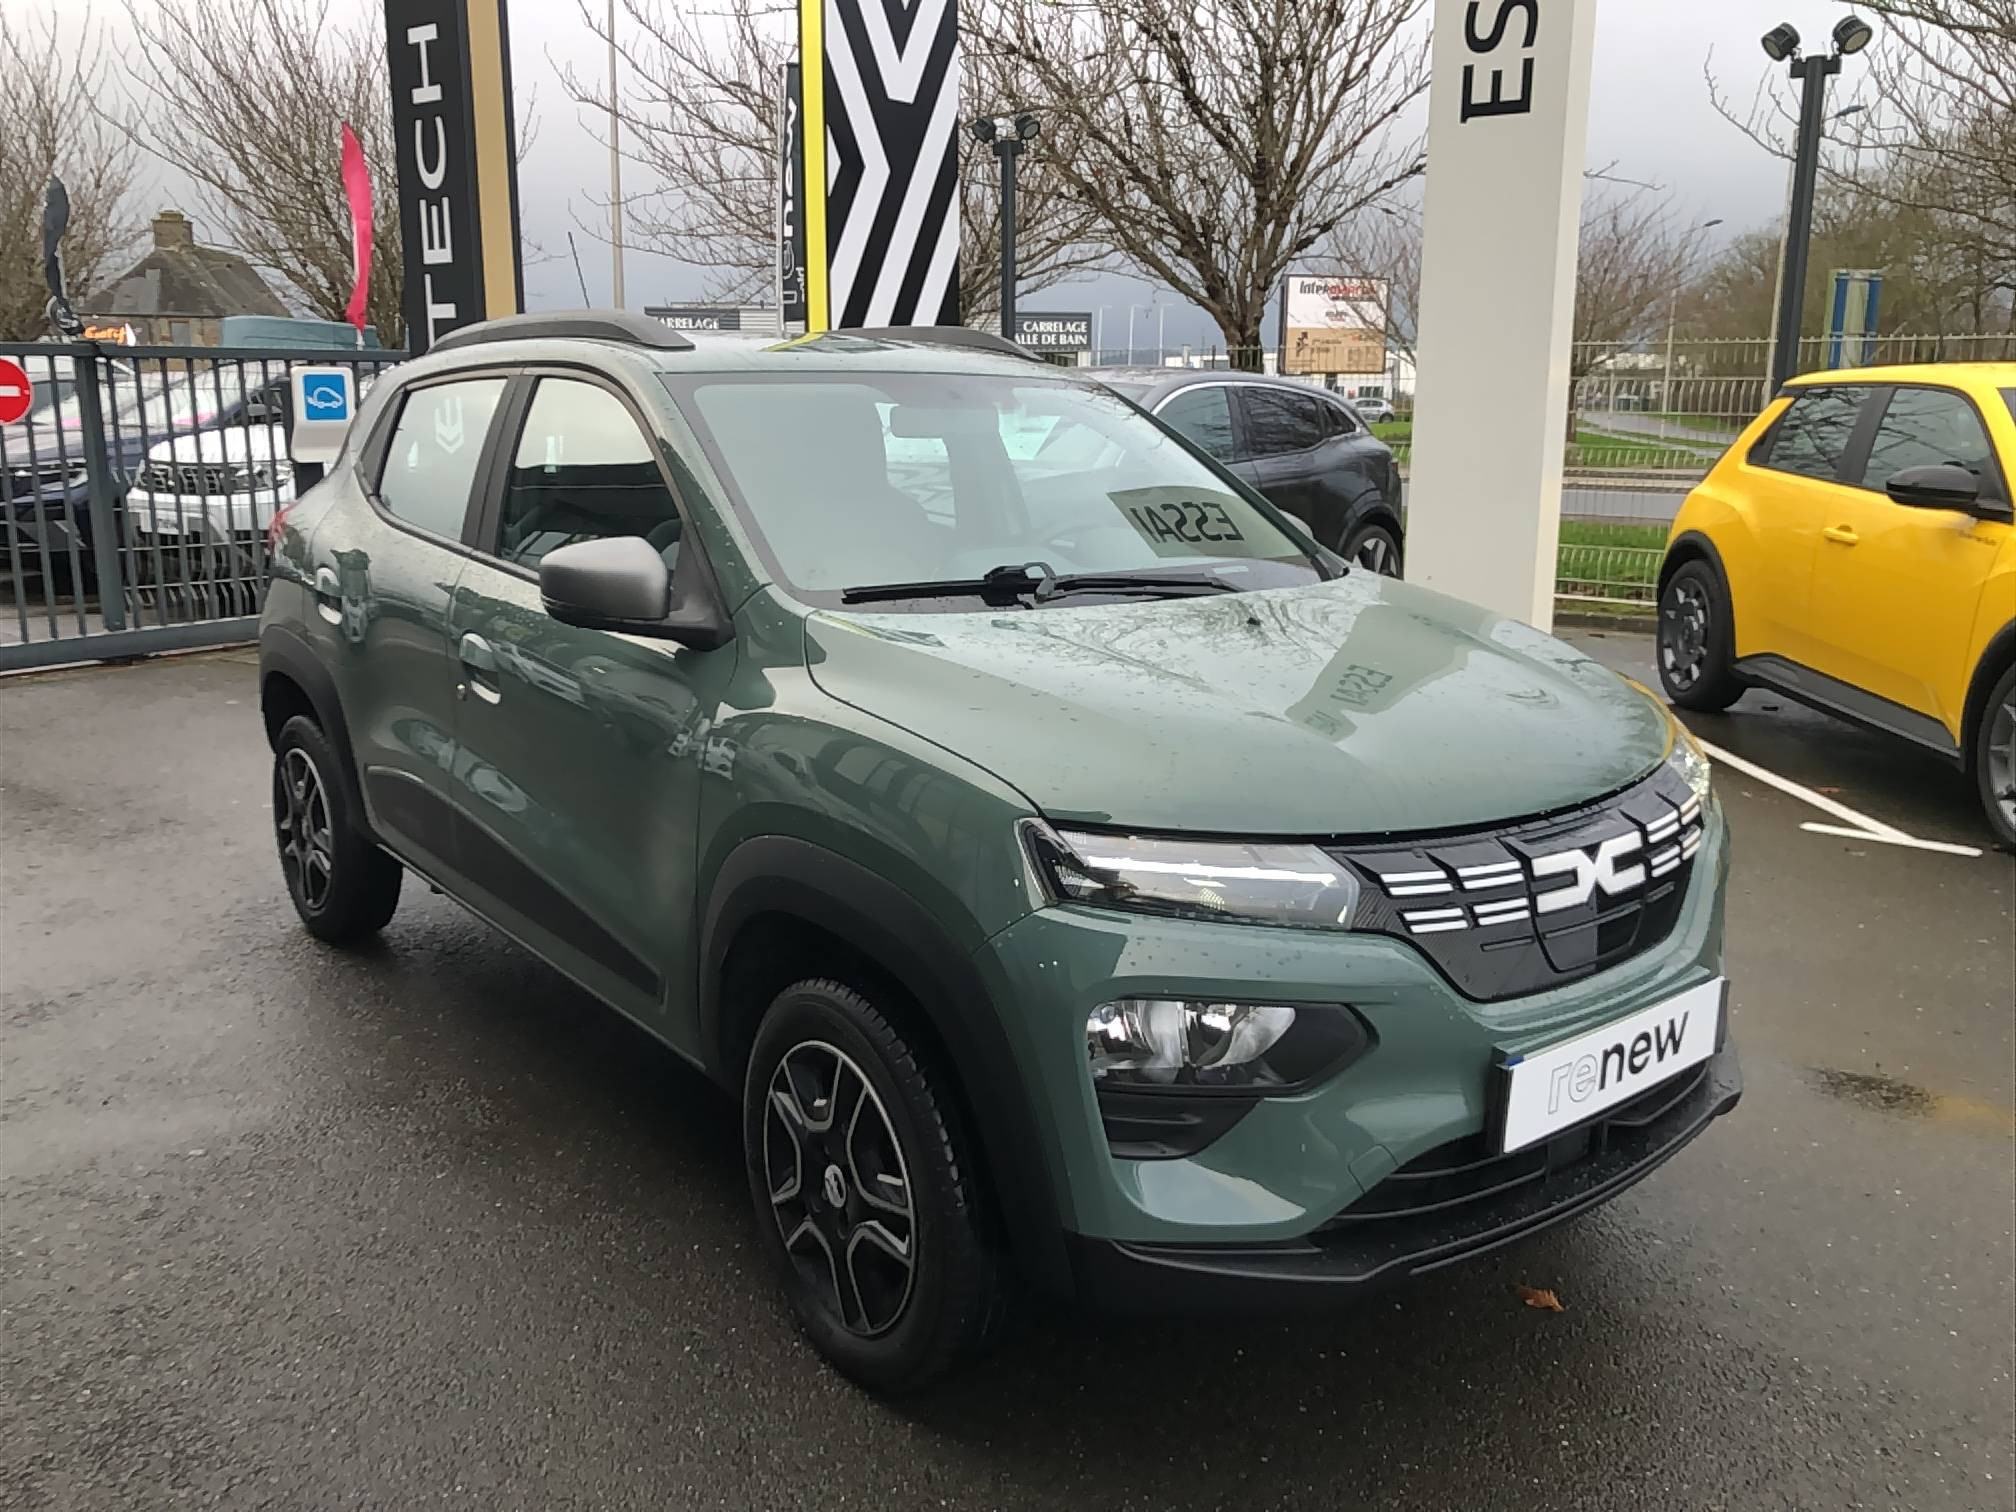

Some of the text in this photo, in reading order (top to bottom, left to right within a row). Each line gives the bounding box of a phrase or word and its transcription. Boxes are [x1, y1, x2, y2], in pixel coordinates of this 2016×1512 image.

[407, 23, 457, 348] TECH
[1023, 321, 1088, 333] CARRELAGE
[1041, 333, 1057, 345] DE
[1059, 333, 1088, 345] BAIN
[1547, 1010, 1690, 1116] renew
